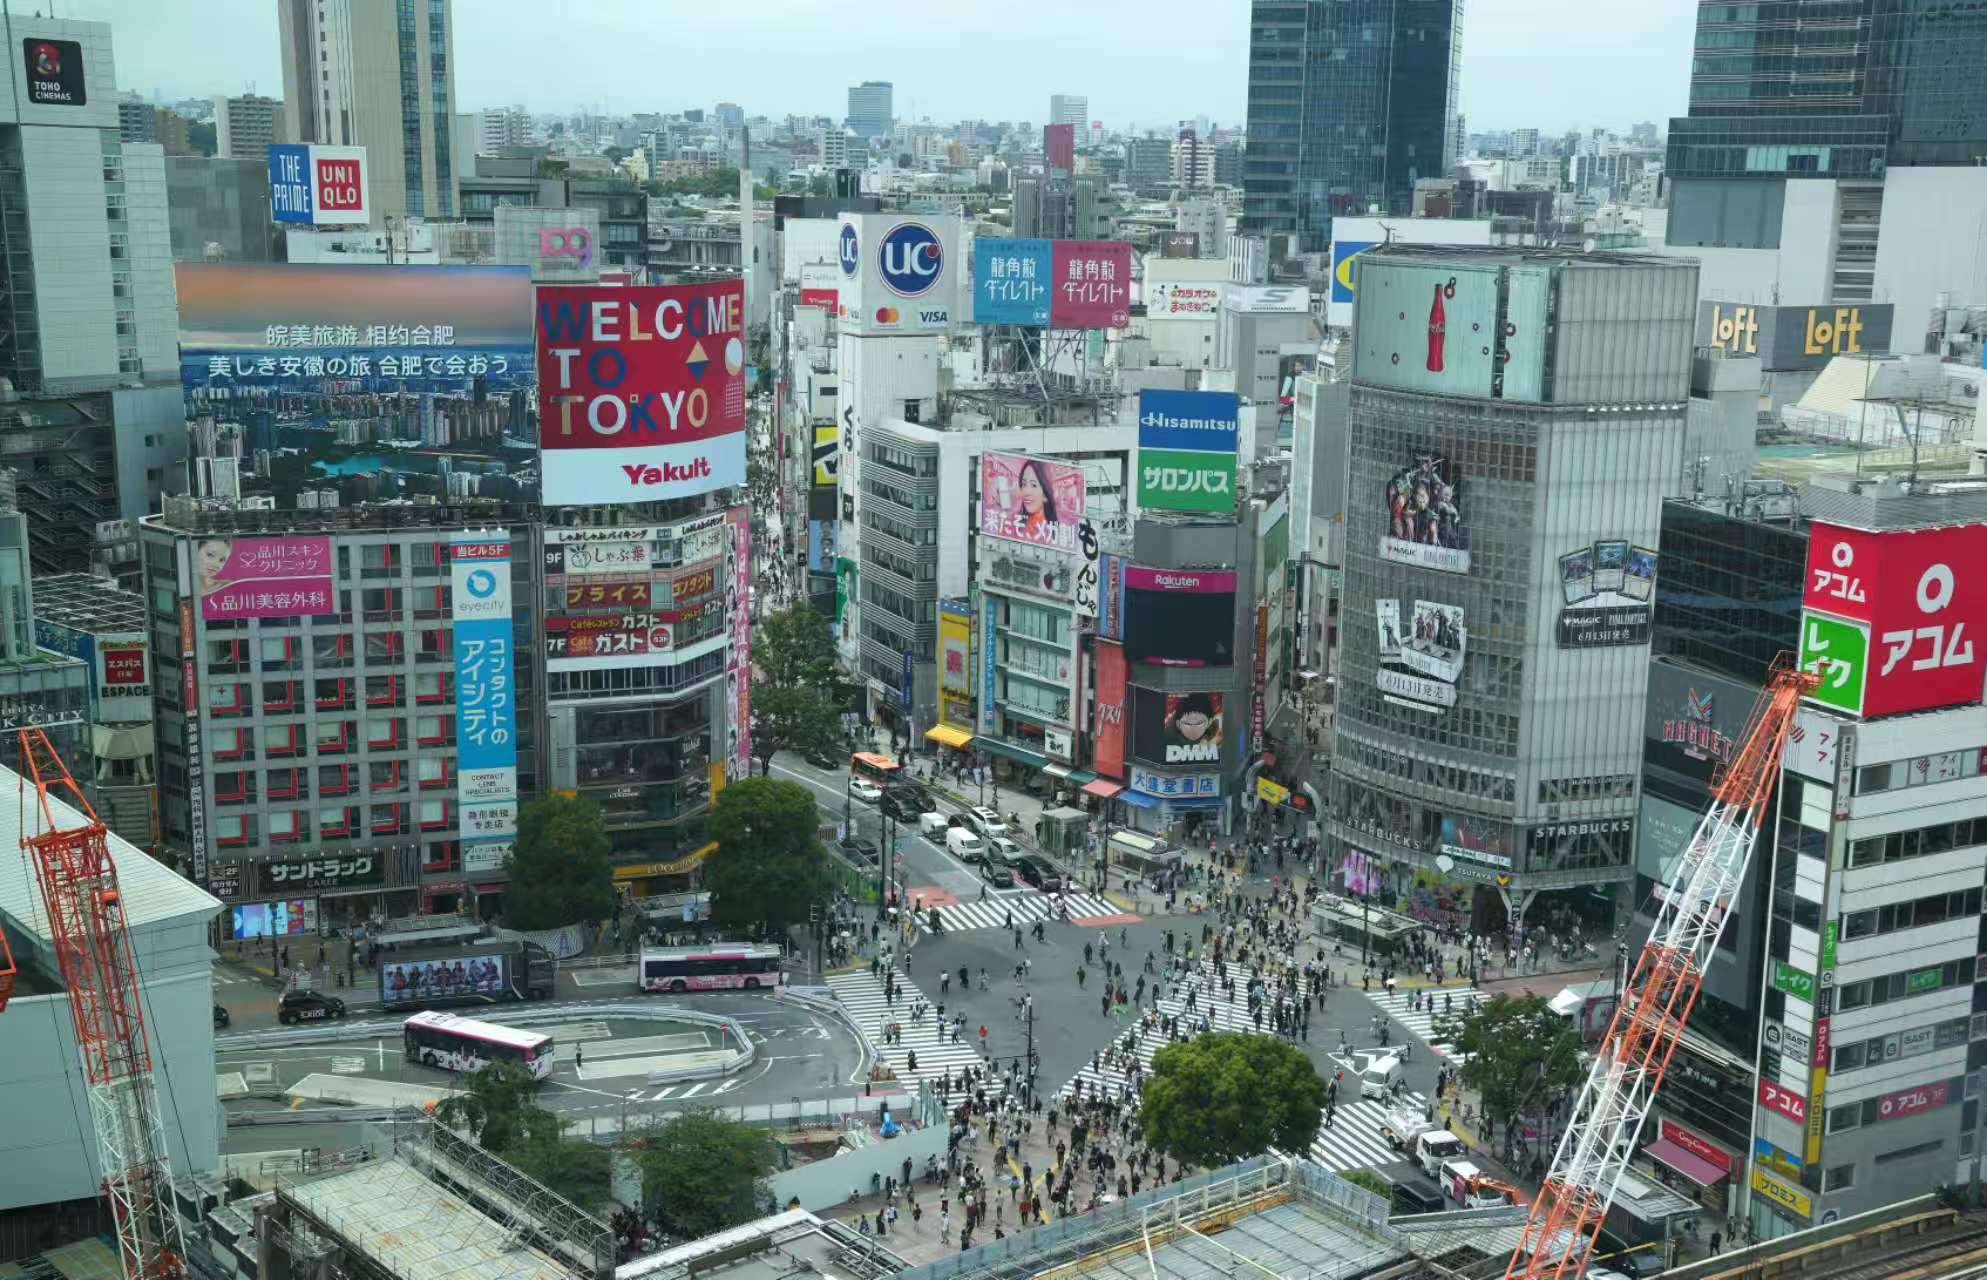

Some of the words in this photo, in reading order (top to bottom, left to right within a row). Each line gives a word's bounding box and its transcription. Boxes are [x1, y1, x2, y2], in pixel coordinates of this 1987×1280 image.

[34, 81, 61, 91] TOHO
[35, 91, 72, 101] CINEMAS
[278, 155, 301, 181] THE
[321, 163, 354, 184] UNI
[273, 182, 310, 214] PRIME
[323, 186, 358, 206] QLO
[886, 241, 940, 276] UC
[991, 256, 1037, 278] 龍角散
[1069, 258, 1116, 281] 龍角散
[984, 280, 1045, 301] ダイレクト
[1063, 282, 1124, 304] ダイレクト
[540, 293, 742, 342] WELCOME
[919, 311, 948, 323] VISA
[266, 325, 359, 348] 皖美旅游
[365, 325, 456, 347] 相约合肥
[208, 355, 370, 378] 美しき安徽の旅
[378, 354, 509, 377] 合肥で会おう
[548, 348, 628, 389] TO
[550, 387, 709, 436] TOKYO
[1140, 411, 1237, 432] Hisamitsu
[622, 456, 712, 486] Yakult
[1143, 465, 1230, 495] サロンパス
[558, 528, 649, 542] しゃぶしゃぶバイキング
[257, 543, 324, 559] 品川スキン
[457, 544, 504, 557] 当ビル5F
[545, 552, 563, 565] 9F
[594, 545, 646, 563] しゃぶ葉
[258, 558, 319, 573] クリニック
[1077, 517, 1099, 616] もんじゃ
[1155, 574, 1200, 588] Rakuten
[1813, 568, 1867, 604] アコム
[221, 591, 327, 611] 品川美容外科
[459, 599, 504, 612] eyecity
[622, 613, 661, 630] ガスト
[1572, 616, 1602, 625] MAGIC
[547, 639, 567, 651] 7F
[595, 632, 644, 653] ガスト
[1881, 622, 1975, 677] アコム
[107, 659, 142, 669] エスパス
[101, 685, 150, 698] ESPACE
[460, 640, 487, 746] アイシティ
[489, 638, 509, 745] コンタクトの
[28, 709, 84, 727] CITY
[1662, 719, 1733, 765] MAGNET
[1165, 744, 1220, 762] DMM
[471, 773, 505, 781] CONTACT
[1135, 770, 1215, 794] 大盛堂書店
[1347, 818, 1420, 849] STARBUCKS
[1536, 820, 1631, 839] STARBUCKS
[225, 867, 238, 875] 2F
[270, 856, 373, 882] サンドラッグ
[1457, 867, 1492, 881] TSUTAYA
[1776, 966, 1812, 991] レイク
[1765, 1086, 1804, 1118] アコム
[1898, 1092, 1928, 1112] アコム
